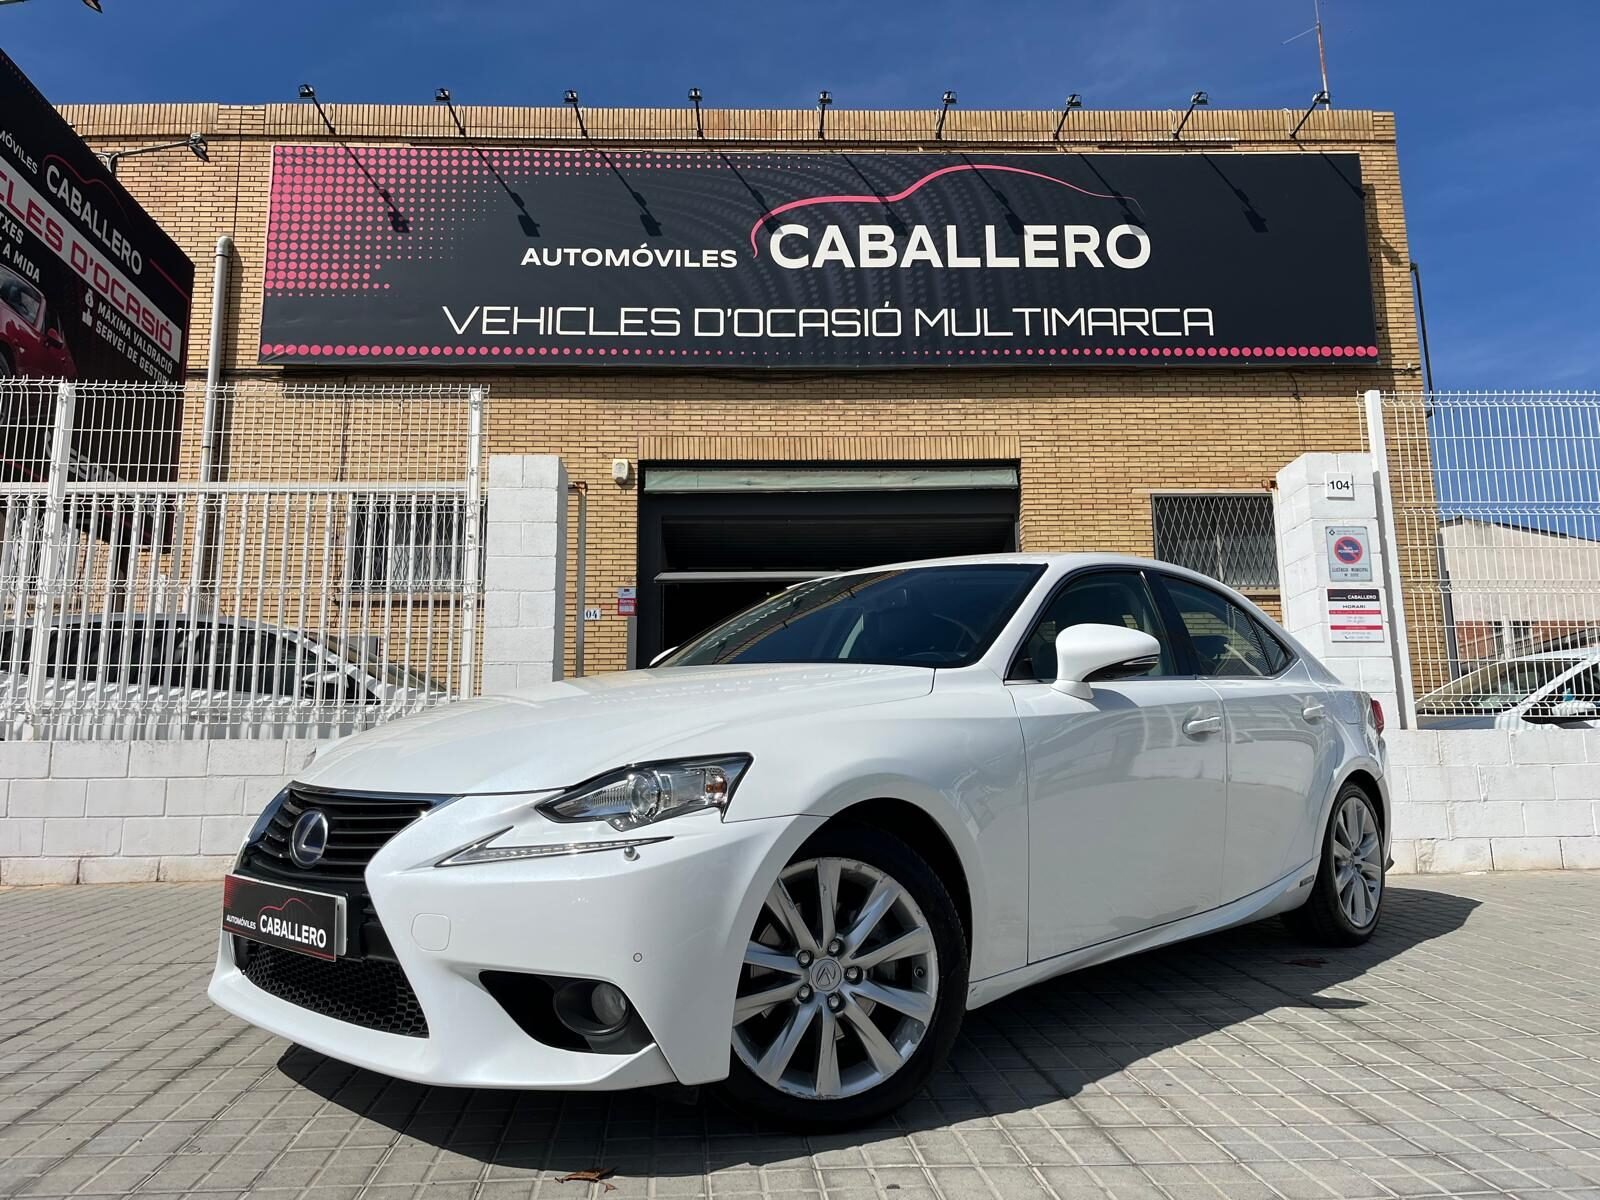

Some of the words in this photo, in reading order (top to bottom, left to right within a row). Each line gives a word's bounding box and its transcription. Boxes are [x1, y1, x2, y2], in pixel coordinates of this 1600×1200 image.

[46, 164, 143, 276] CABALLERO
[2, 242, 11, 259] A
[13, 249, 41, 283] MIDA
[520, 243, 738, 268] AUTOMÓVILES
[769, 224, 1151, 269] CABALLERO
[70, 239, 173, 352] D'OCASIÓ
[441, 305, 681, 337] VEHICLES
[693, 300, 902, 338] D'OCASIÓ
[914, 307, 1215, 338] MULTIMARCA
[95, 320, 126, 354] SERVEI
[127, 345, 139, 364] DE
[139, 356, 175, 386] GESTOR
[133, 331, 173, 375] VALORACIÓ
[1328, 480, 1350, 491] 104
[226, 913, 257, 930] AUTOMÓVILES
[259, 914, 327, 949] CABALLERO
